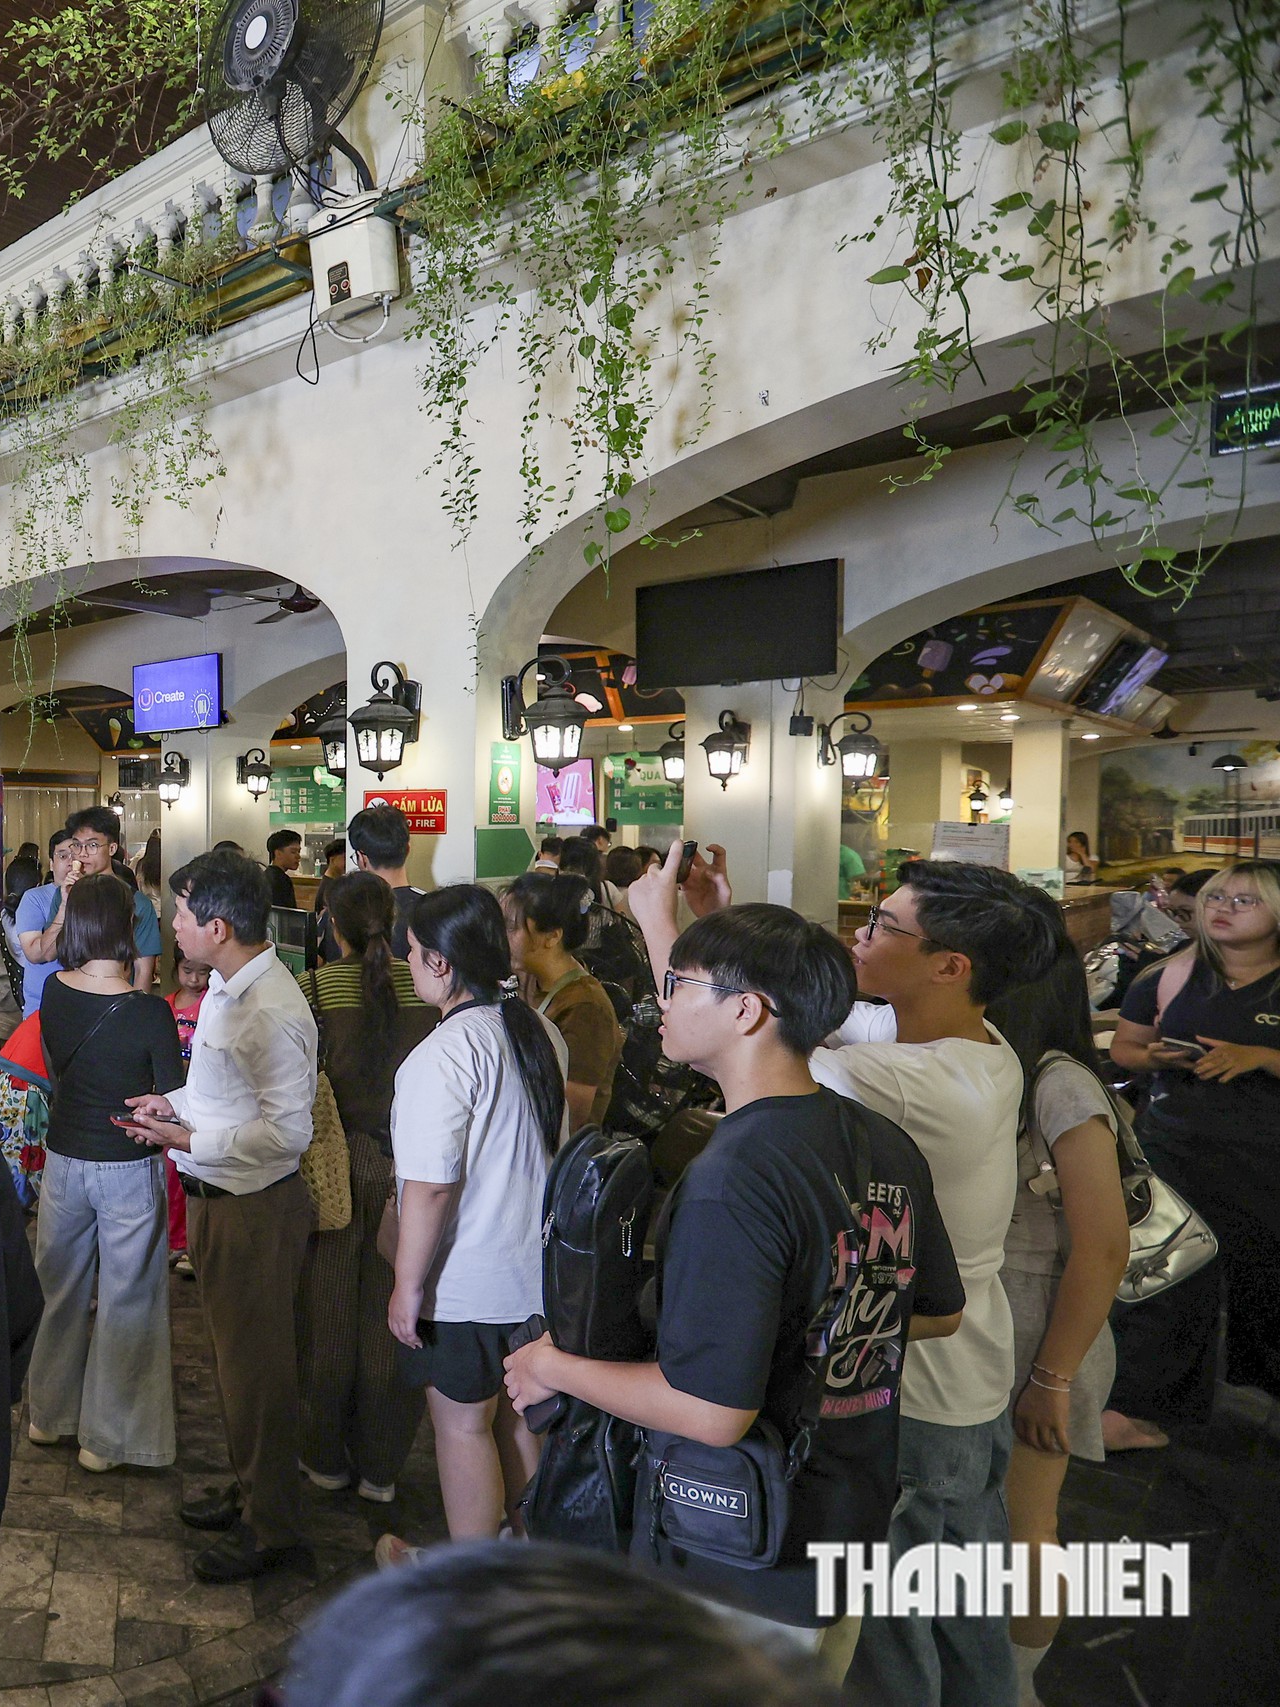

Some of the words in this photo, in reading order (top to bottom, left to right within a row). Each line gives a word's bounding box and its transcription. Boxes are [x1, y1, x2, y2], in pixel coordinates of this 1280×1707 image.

[154, 690, 185, 704] Create
[392, 796, 416, 812] CẤM
[421, 795, 444, 812] LỬA
[415, 819, 436, 828] FIRE
[668, 1482, 739, 1510] CLOWNZ
